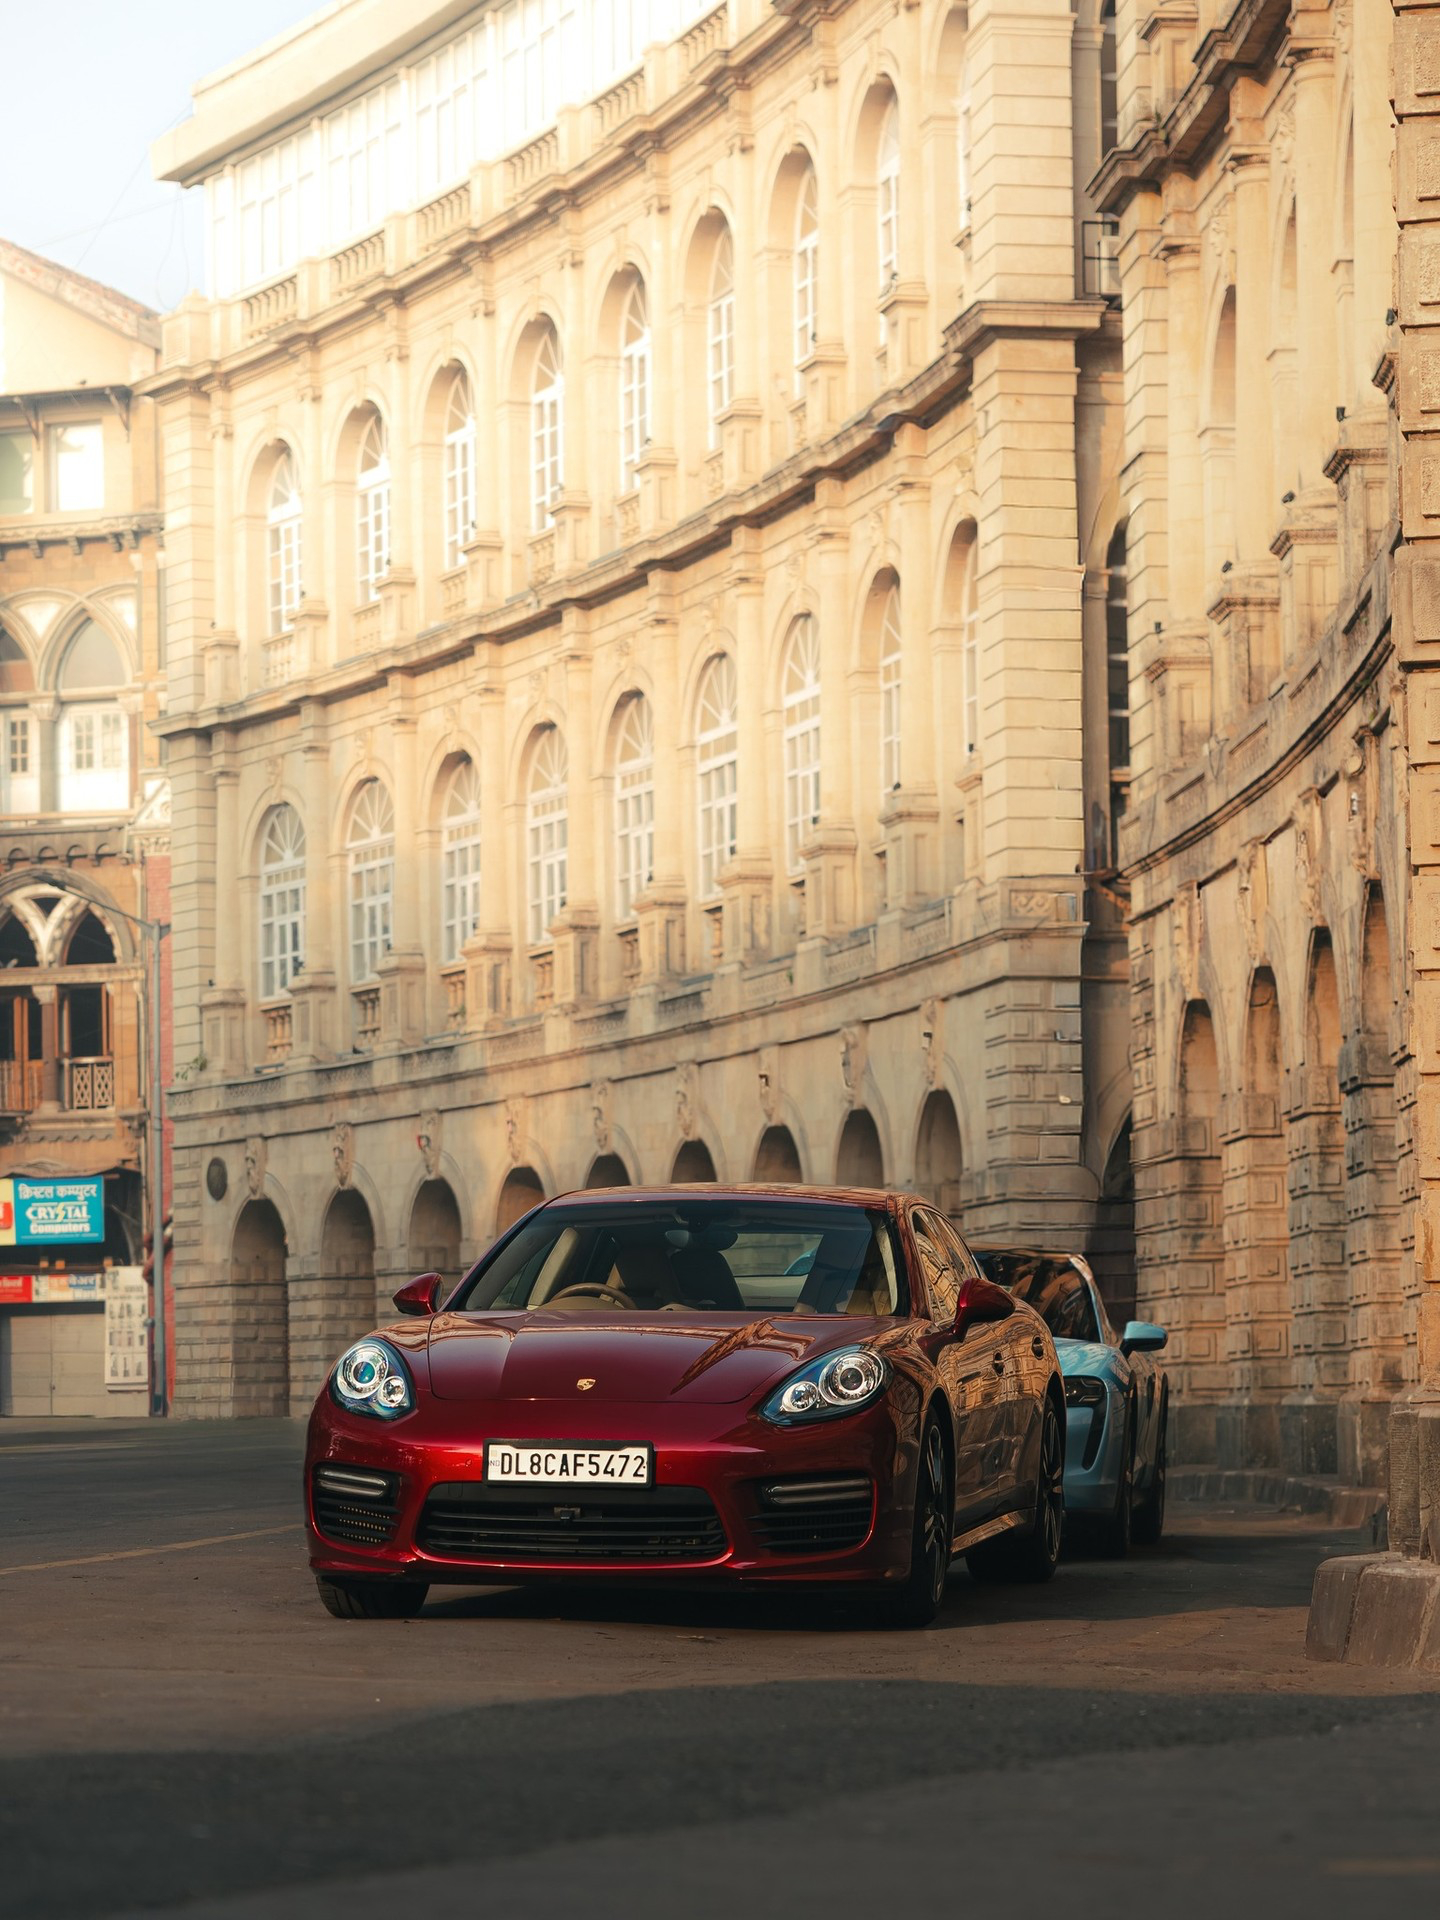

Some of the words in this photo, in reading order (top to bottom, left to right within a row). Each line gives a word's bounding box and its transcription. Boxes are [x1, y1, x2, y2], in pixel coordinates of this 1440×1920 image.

[26, 1204, 90, 1221] CRYSTAL
[30, 1222, 90, 1233] Computers
[501, 1453, 644, 1477] DL8CAF5472
